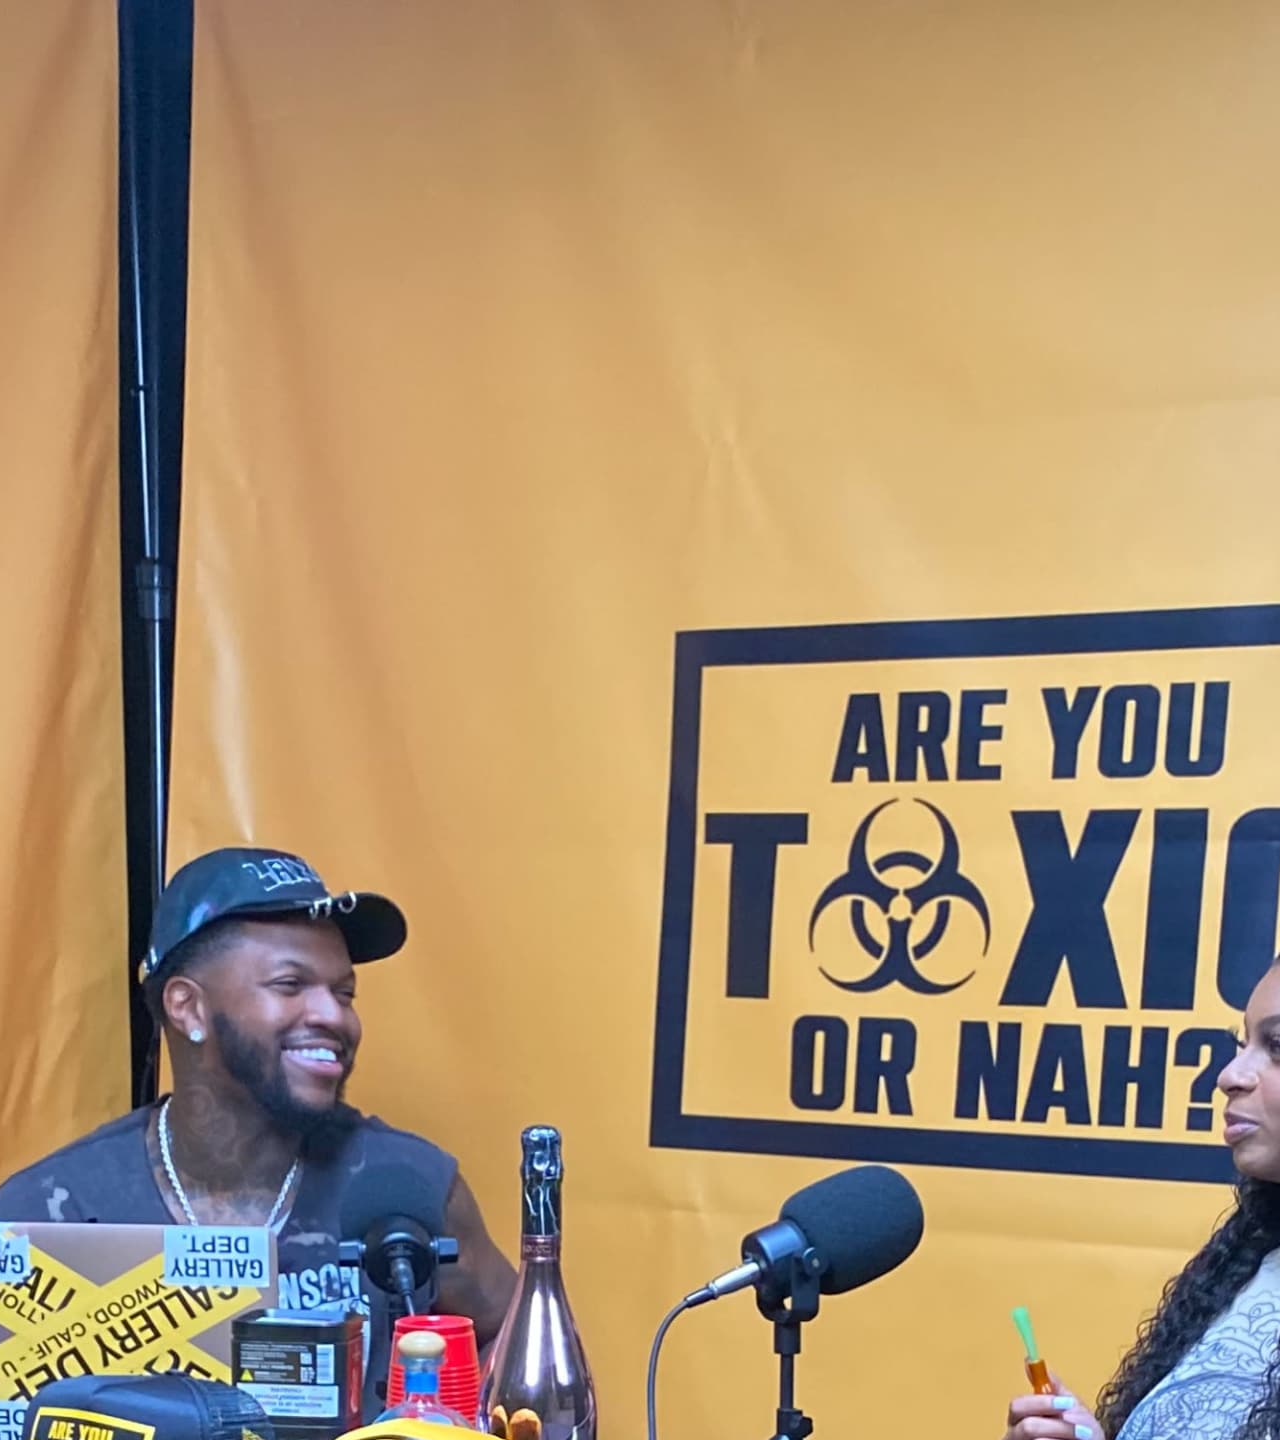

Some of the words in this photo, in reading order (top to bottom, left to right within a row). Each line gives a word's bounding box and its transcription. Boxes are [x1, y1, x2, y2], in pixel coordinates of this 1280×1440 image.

[831, 689, 1007, 783] ARE
[1042, 681, 1230, 779] YOU
[790, 1015, 917, 1116] OR
[954, 1021, 1238, 1132] NAH?
[182, 1235, 250, 1254] DEPT.
[171, 1257, 263, 1279] GALLERY
[29, 1322, 86, 1359] CALIF.
[48, 1420, 75, 1440] ARE
